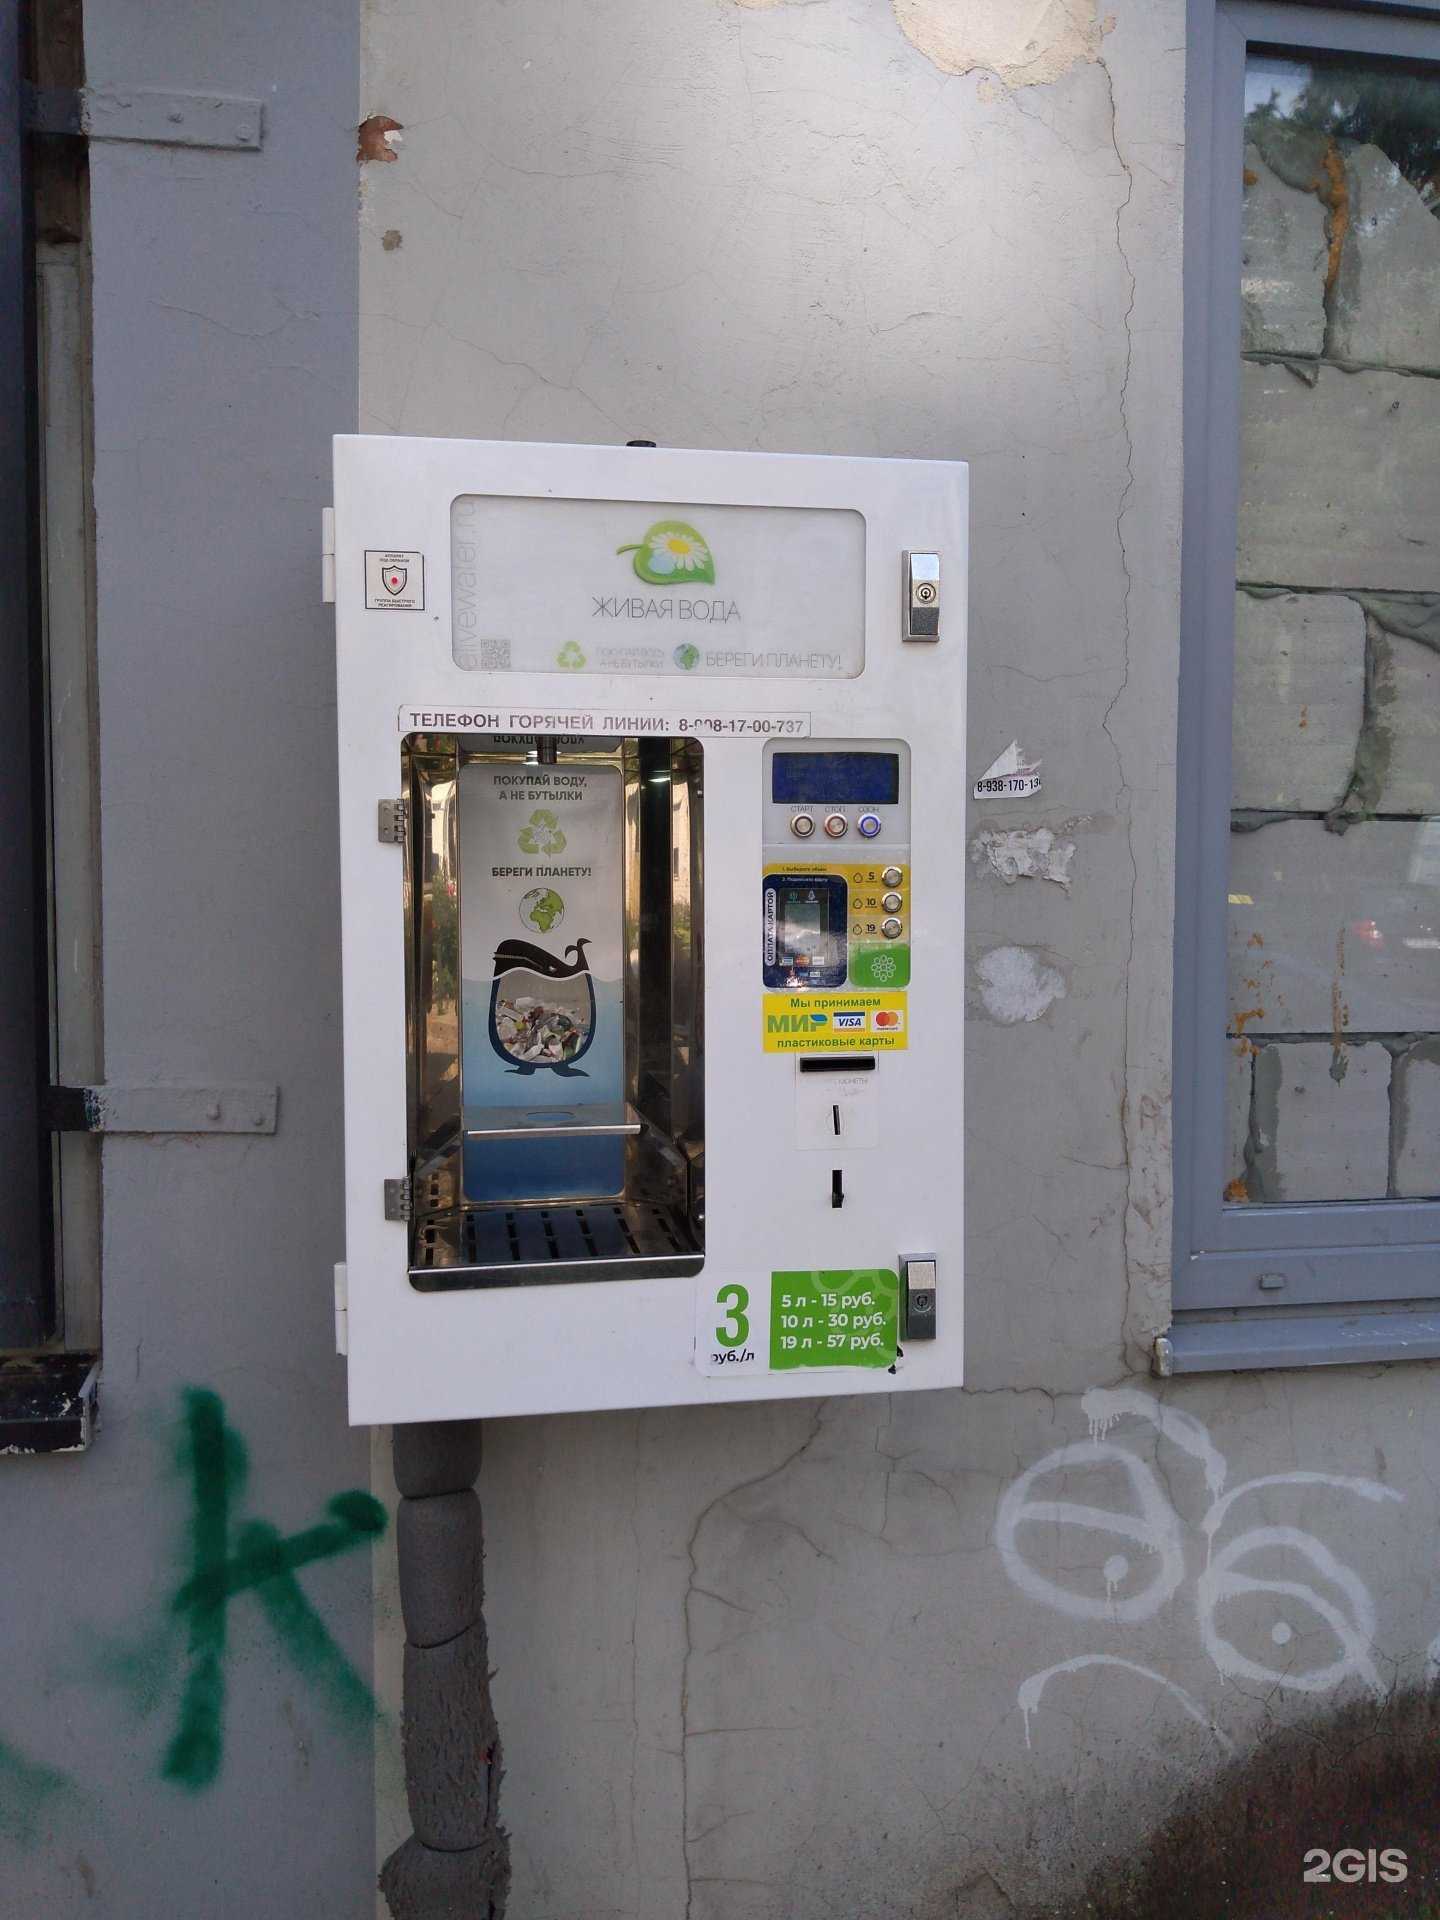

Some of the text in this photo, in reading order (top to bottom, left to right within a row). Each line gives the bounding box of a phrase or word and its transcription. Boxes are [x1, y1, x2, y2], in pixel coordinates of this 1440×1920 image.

[592, 597, 742, 624] ЖИВАЯ ВОДА
[706, 652, 766, 668] БЕРЕГИ
[410, 712, 499, 728] ТЕЛЕФОН
[509, 713, 593, 730] ГОРЯЧЕЙ
[602, 716, 670, 732] ЛИНИИ:
[493, 774, 587, 788] ПОКУПАЙ ВОДУ,
[499, 790, 583, 801] А НЕ БУТЫЛКИ
[491, 867, 592, 877] БЕРЕГИ ПЛАНЕТУ!
[868, 872, 875, 880] 5
[867, 898, 877, 906] 10
[866, 924, 876, 932] 19
[790, 998, 881, 1009] Мы принимаем
[767, 1013, 828, 1033] МИР
[838, 1018, 862, 1027] VISA
[777, 1036, 895, 1048] пластиковые карты
[782, 1294, 792, 1308] 5
[795, 1296, 806, 1307] л
[821, 1293, 837, 1306] 15
[842, 1291, 875, 1309] руб.
[715, 1284, 750, 1348] 3
[781, 1314, 798, 1328] 10
[802, 1317, 813, 1328] л
[828, 1313, 848, 1327] 30
[853, 1311, 886, 1329] руб.
[780, 1335, 797, 1349] 19
[801, 1337, 812, 1349] л
[827, 1334, 846, 1348] 57
[850, 1332, 884, 1350] руб.
